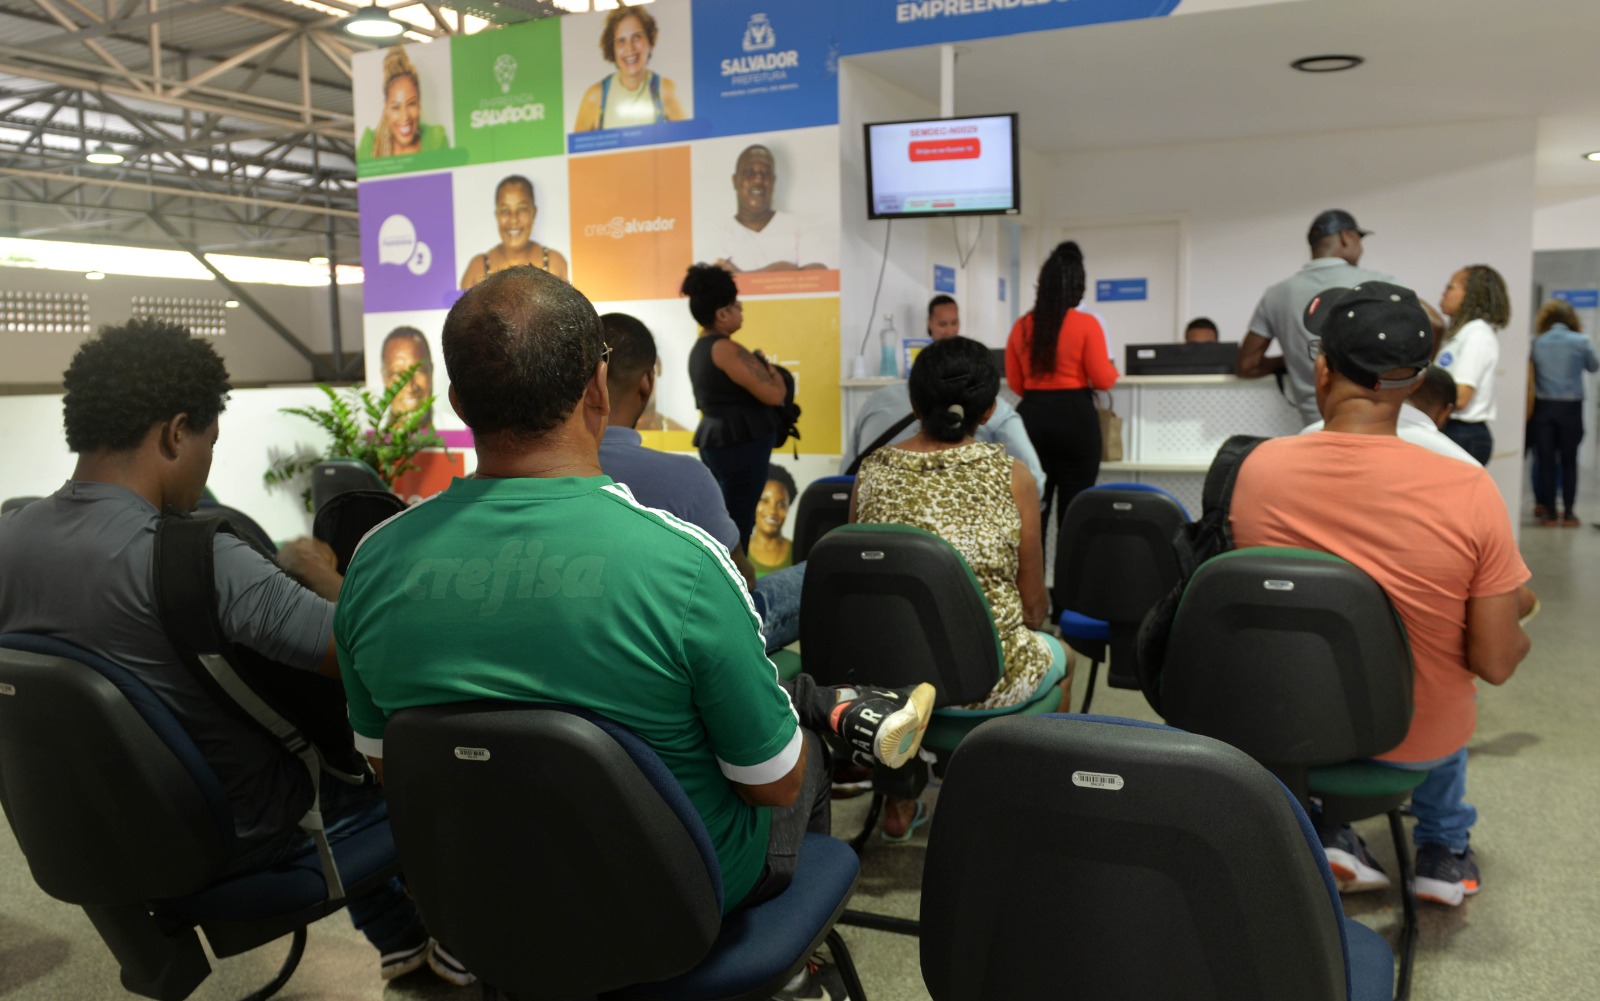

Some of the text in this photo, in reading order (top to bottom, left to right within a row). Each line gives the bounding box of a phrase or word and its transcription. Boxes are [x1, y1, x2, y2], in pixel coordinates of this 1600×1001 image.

[721, 50, 799, 76] SALVADOR
[470, 103, 545, 129] SALVADOR
[403, 539, 606, 617] crefisa
